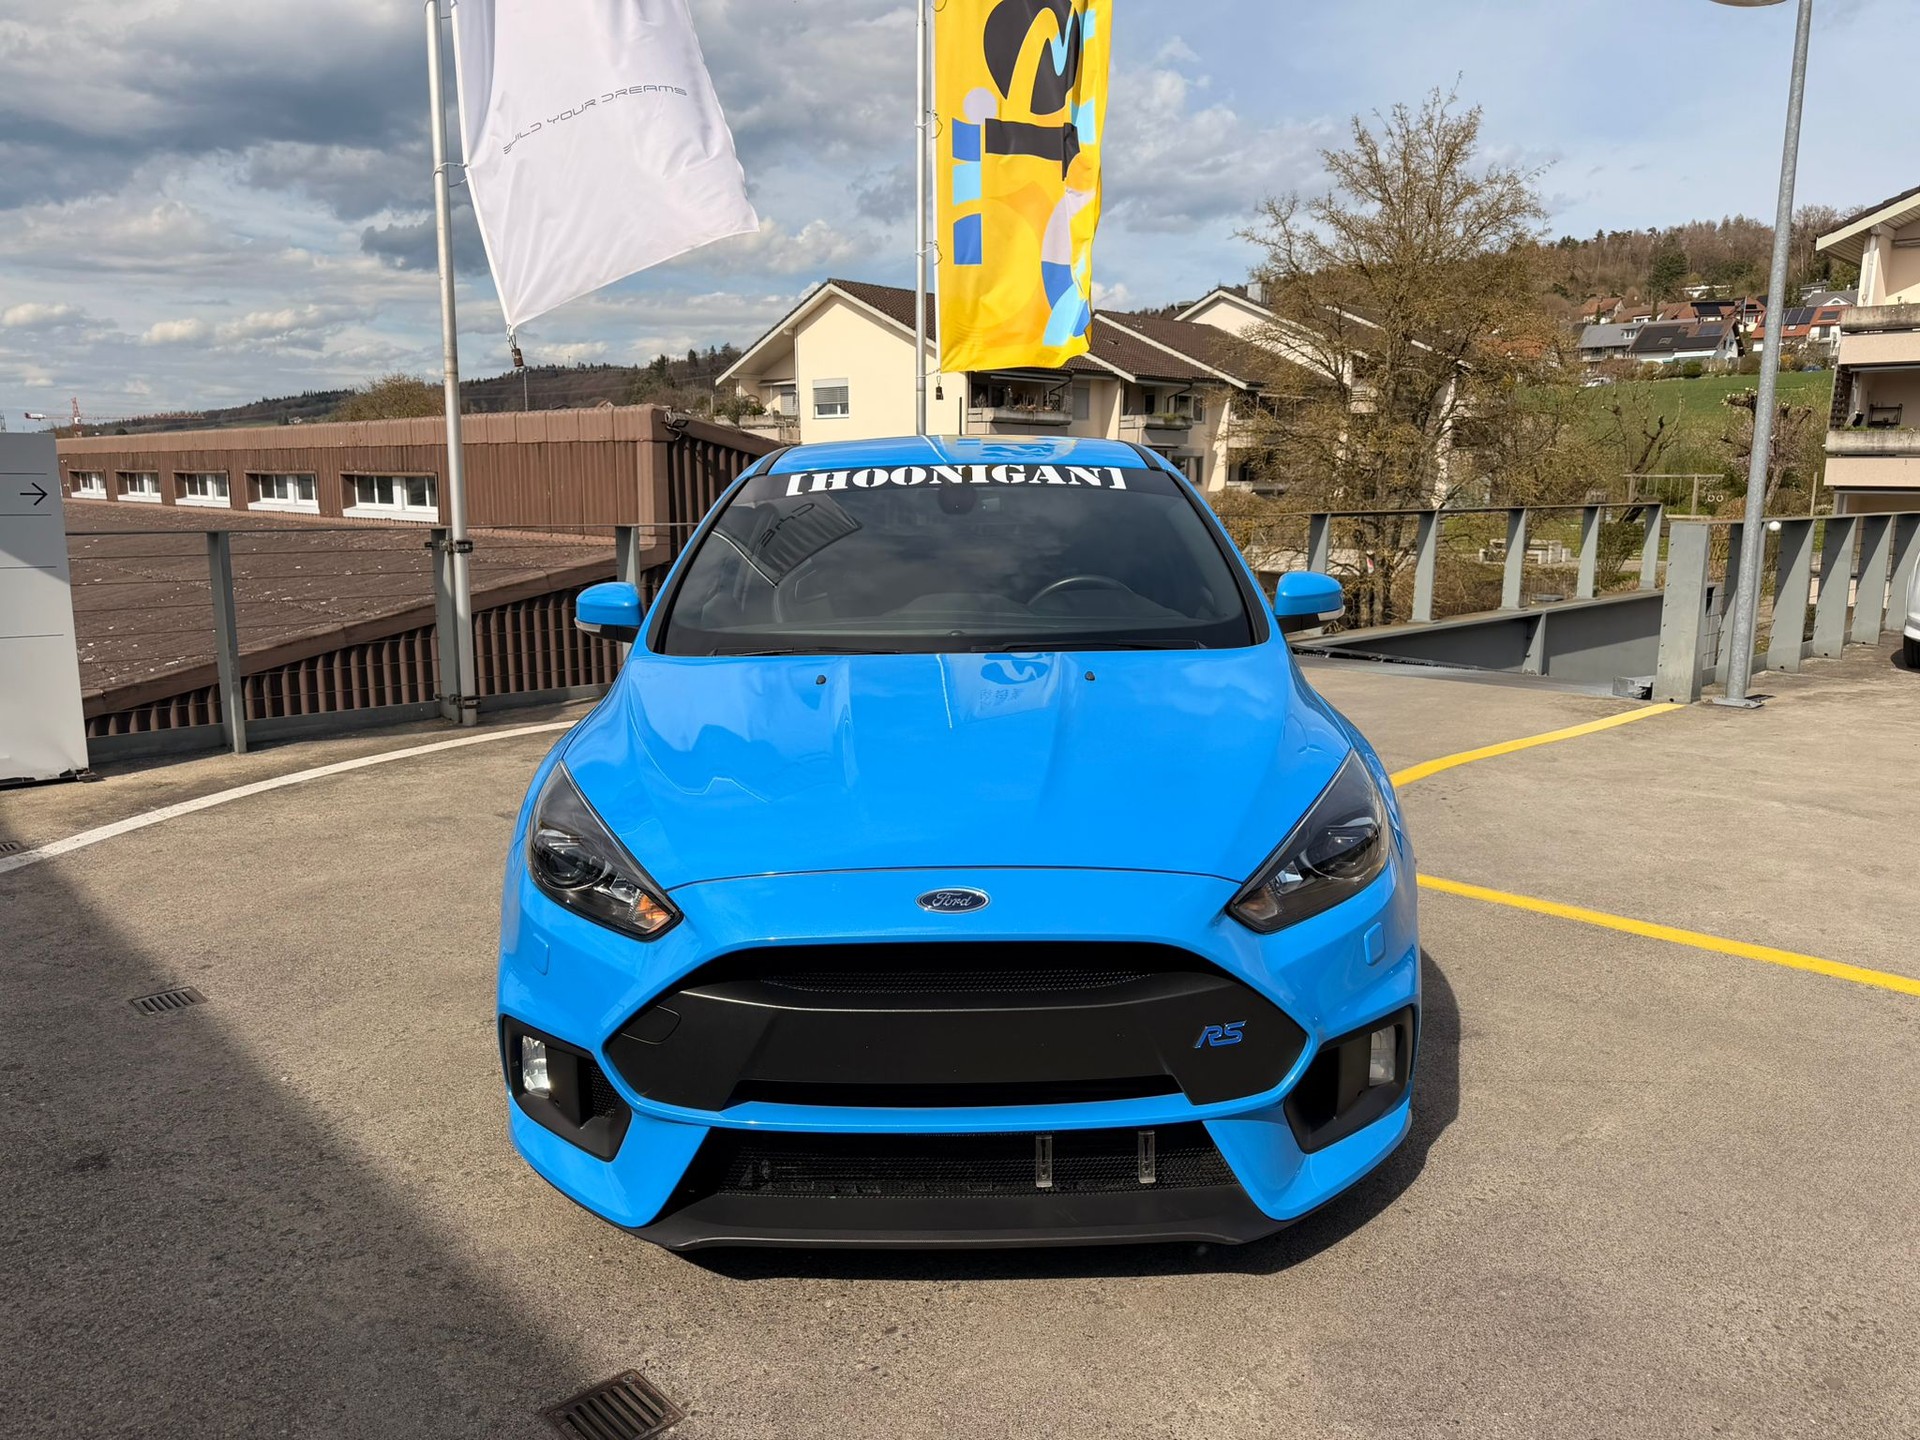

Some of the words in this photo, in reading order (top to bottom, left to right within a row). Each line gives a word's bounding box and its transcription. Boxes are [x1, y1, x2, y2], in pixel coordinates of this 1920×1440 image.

[546, 98, 597, 124] YOUR
[600, 84, 688, 103] DREAMS
[931, 891, 974, 907] Ford
[1192, 1020, 1247, 1049] RS
